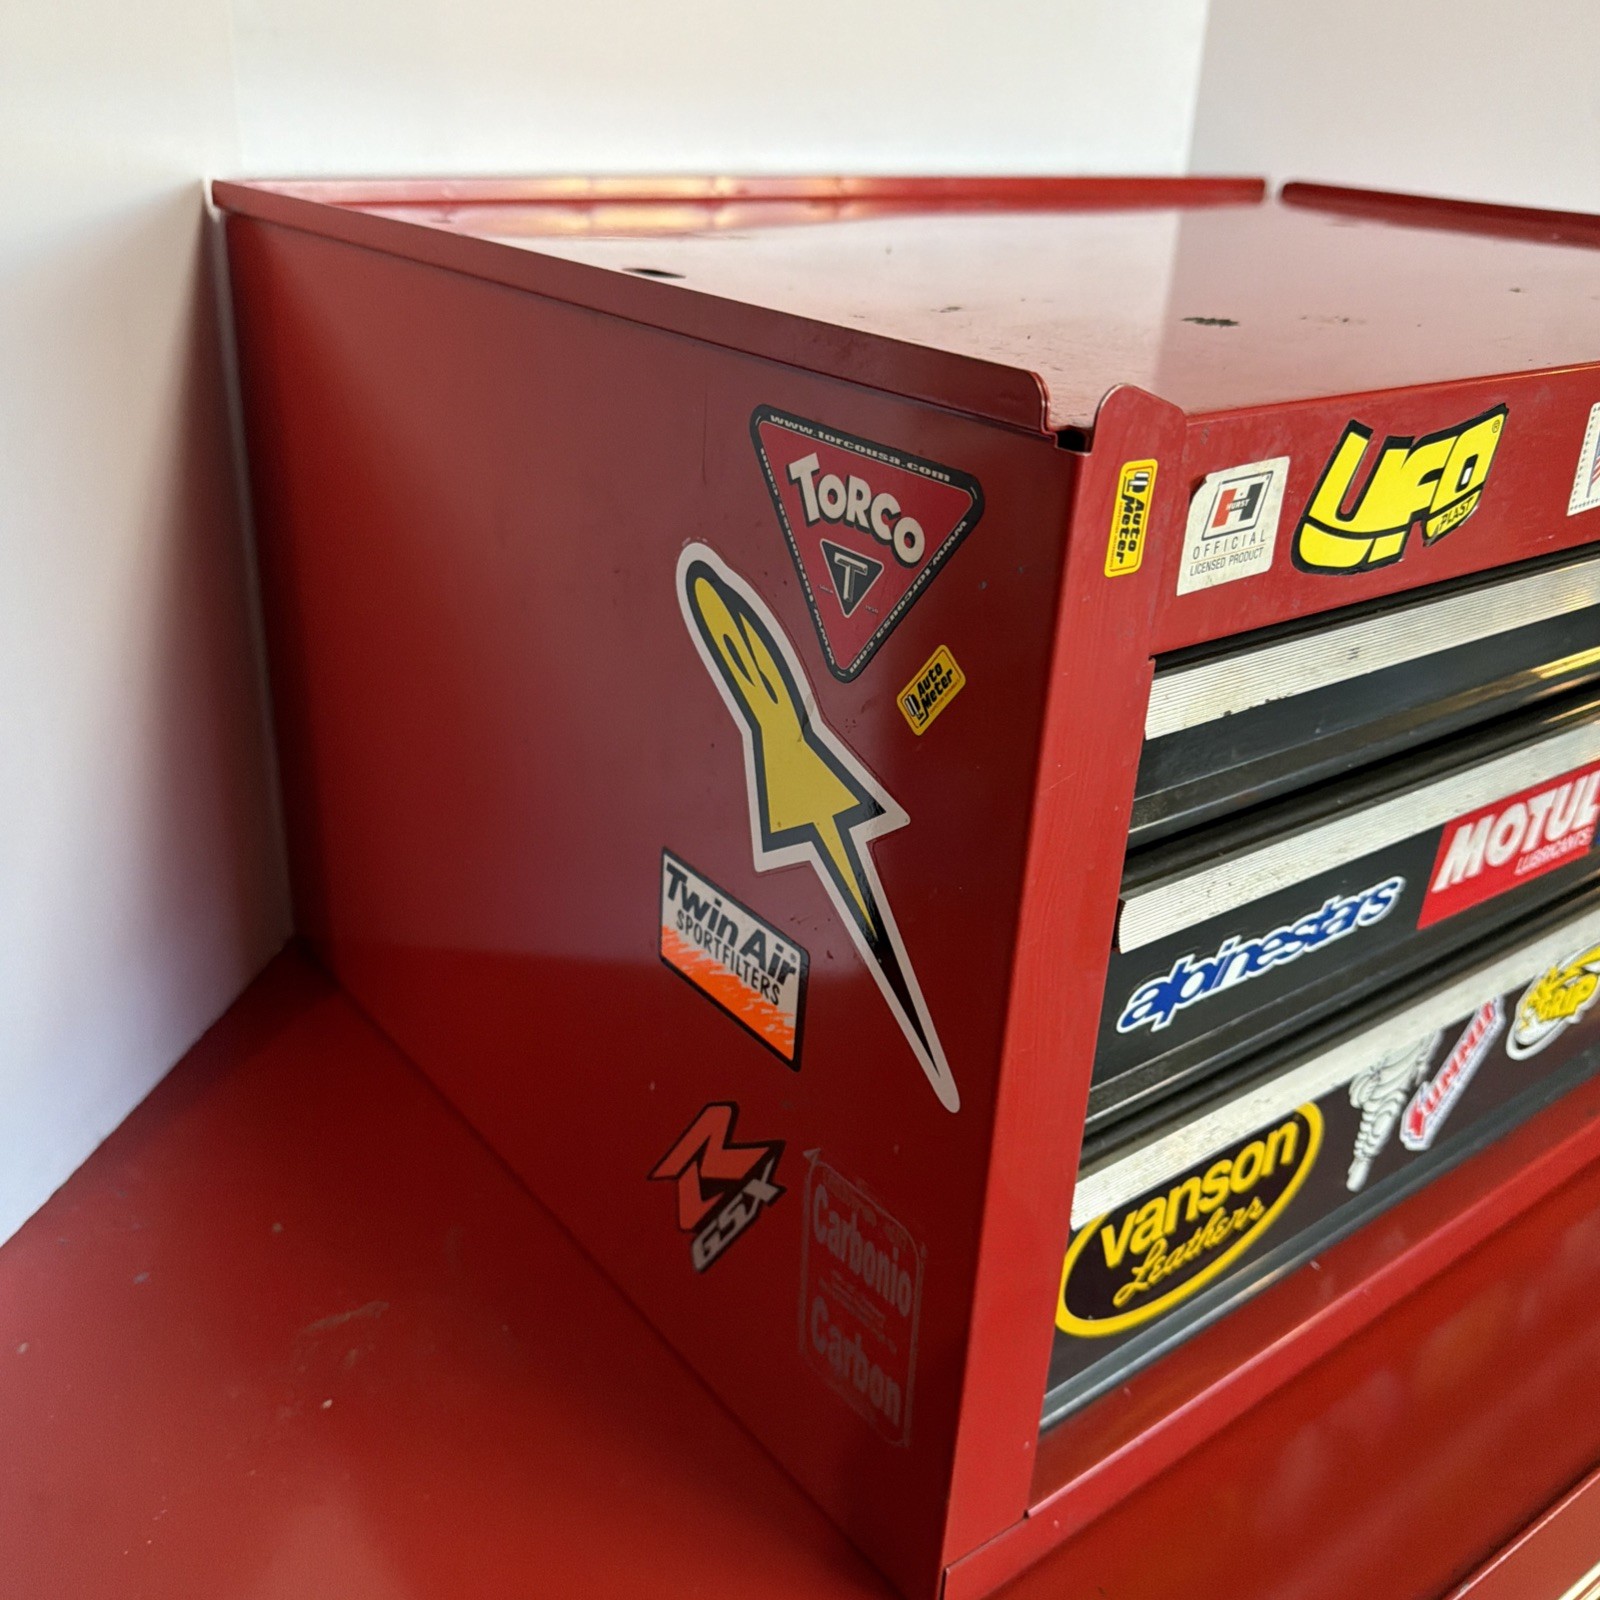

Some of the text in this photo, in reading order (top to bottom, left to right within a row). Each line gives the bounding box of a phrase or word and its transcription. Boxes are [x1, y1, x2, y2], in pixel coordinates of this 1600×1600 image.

[770, 414, 950, 483] www.torcousa.com
[1296, 408, 1506, 572] UFO
[789, 452, 925, 565] TORCO
[1116, 494, 1135, 564] Meter
[1129, 499, 1145, 552] Auto
[1189, 547, 1265, 577] LICENSED PRODUCT
[1193, 529, 1266, 560] OFFICIAL
[1438, 495, 1475, 530] PLAST
[917, 663, 942, 698] Auto
[921, 668, 953, 709] Meter
[1431, 769, 1600, 893] MOTUL
[666, 863, 797, 986] Twin Air
[676, 909, 781, 1006] SPORTFILTERS
[1117, 877, 1405, 1032] alpinestars
[693, 1157, 781, 1271] GSX
[813, 1184, 912, 1317] Carbonio
[1101, 1121, 1298, 1268] vanson
[1113, 1196, 1265, 1308] Leathers
[811, 1296, 901, 1427] Carbon
